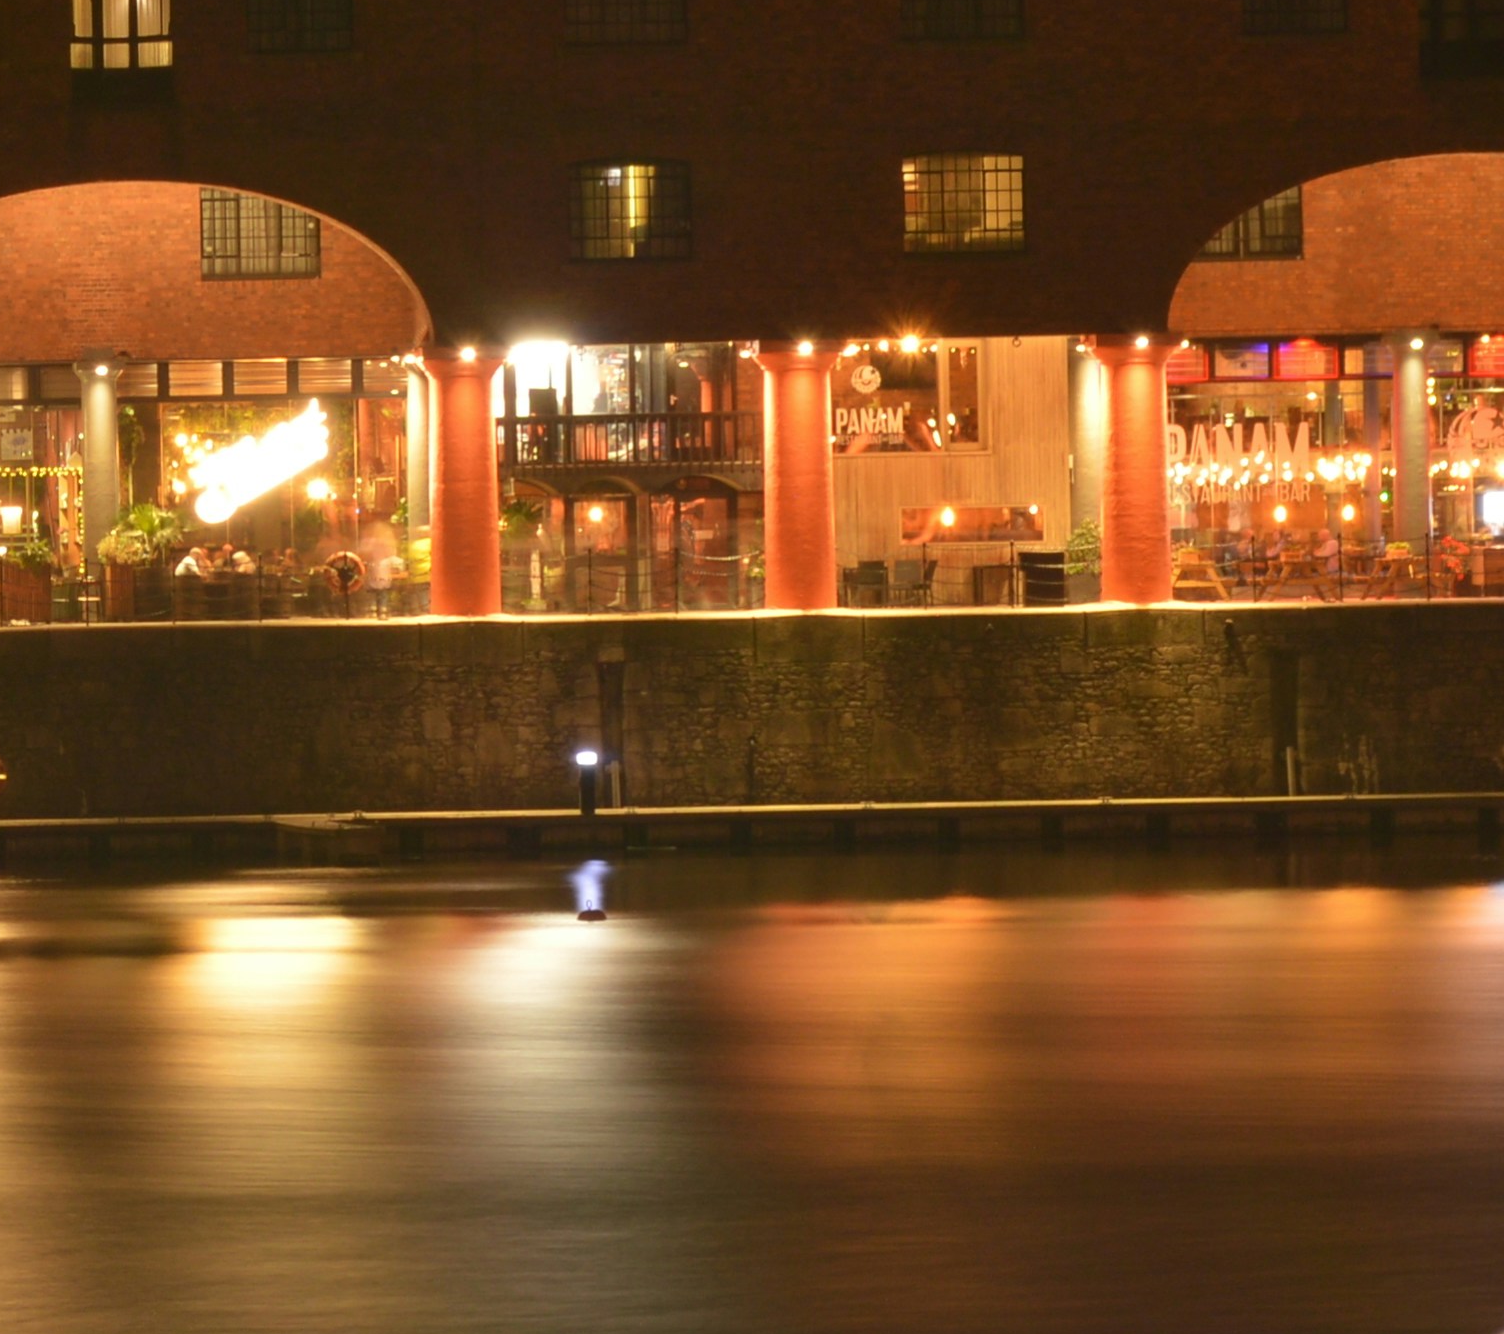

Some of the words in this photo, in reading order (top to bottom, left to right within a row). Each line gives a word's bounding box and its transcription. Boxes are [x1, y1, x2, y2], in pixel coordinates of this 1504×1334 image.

[836, 407, 905, 434] PANAM
[1166, 421, 1310, 483] PANAM
[1279, 481, 1311, 503] BAR
